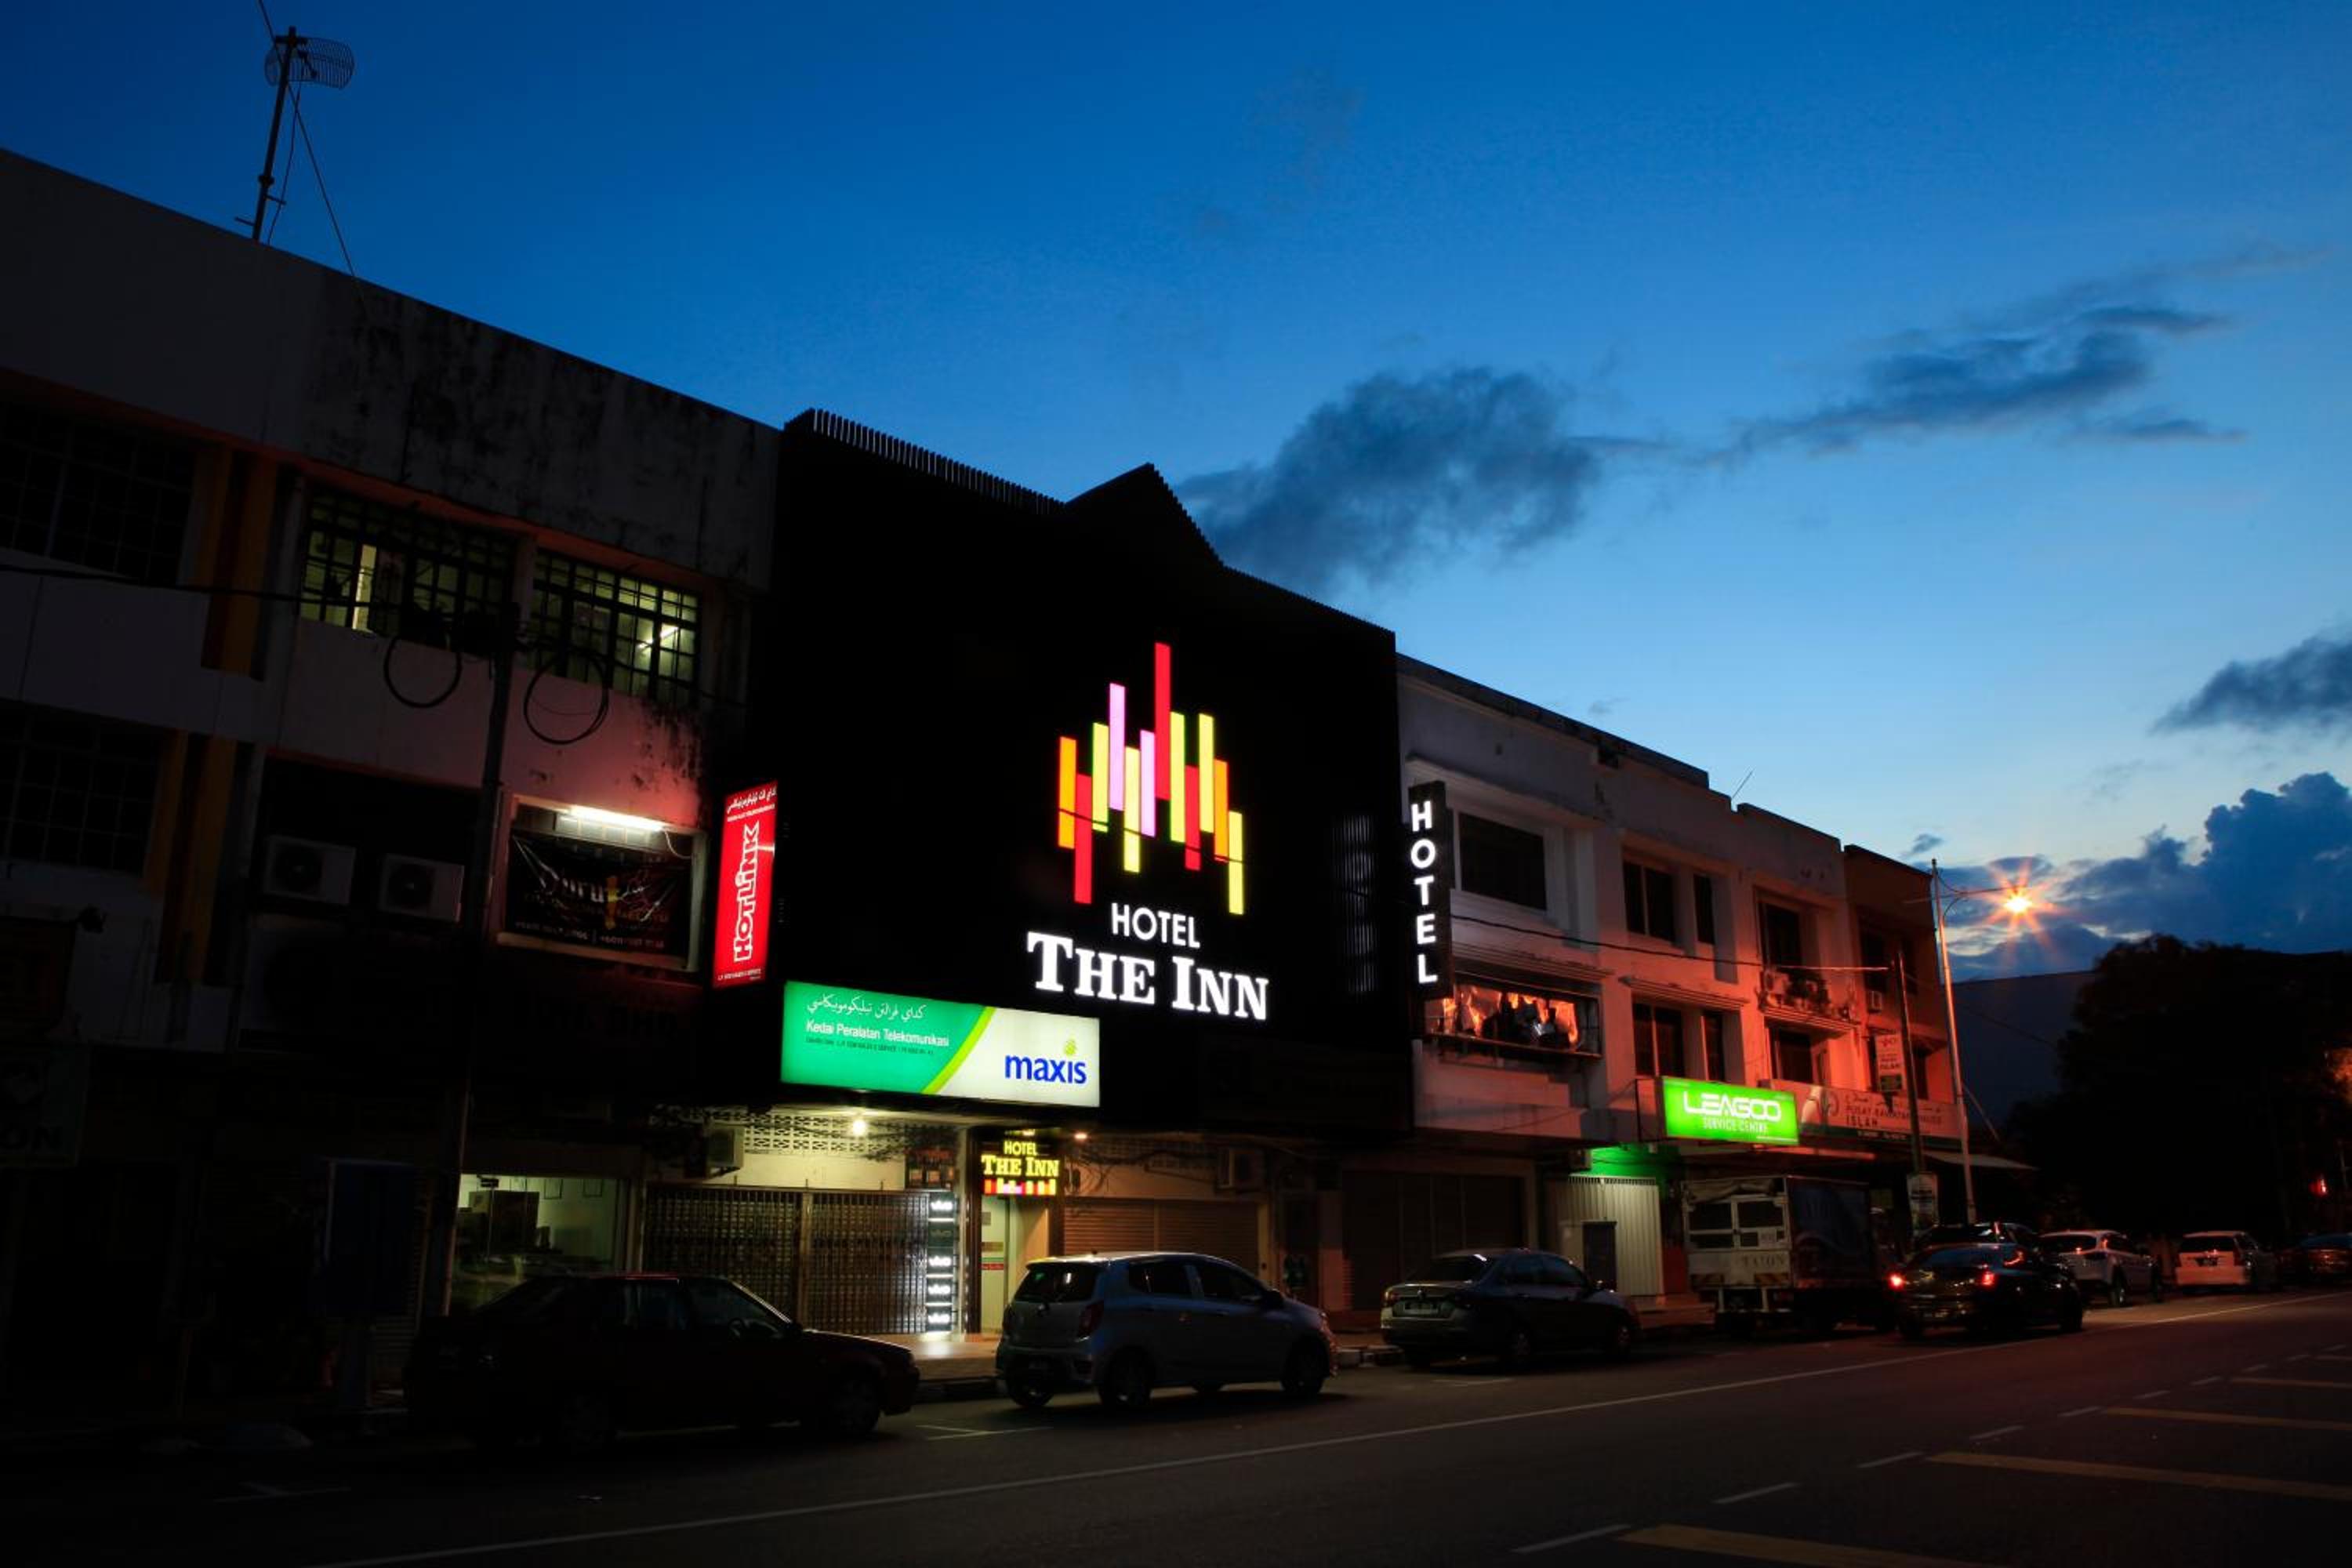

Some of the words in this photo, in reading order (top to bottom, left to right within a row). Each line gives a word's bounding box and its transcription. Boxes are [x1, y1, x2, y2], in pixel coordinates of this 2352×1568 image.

[1410, 800, 1439, 984] HOTEL
[1112, 902, 1200, 949] HOTEL
[1027, 931, 1156, 1005] THE
[1171, 956, 1269, 1020] INN
[806, 1020, 834, 1035] Kedai
[837, 1023, 880, 1040] Peralatan
[884, 1029, 949, 1047] Telekomunikasi
[1005, 1054, 1087, 1084] maxis
[1683, 1091, 1782, 1123] LEAGOO
[1703, 1116, 1736, 1131] SERVICE
[1004, 1140, 1038, 1156] HOTEL
[981, 1154, 1022, 1175] THE
[1025, 1156, 1059, 1177] INN
